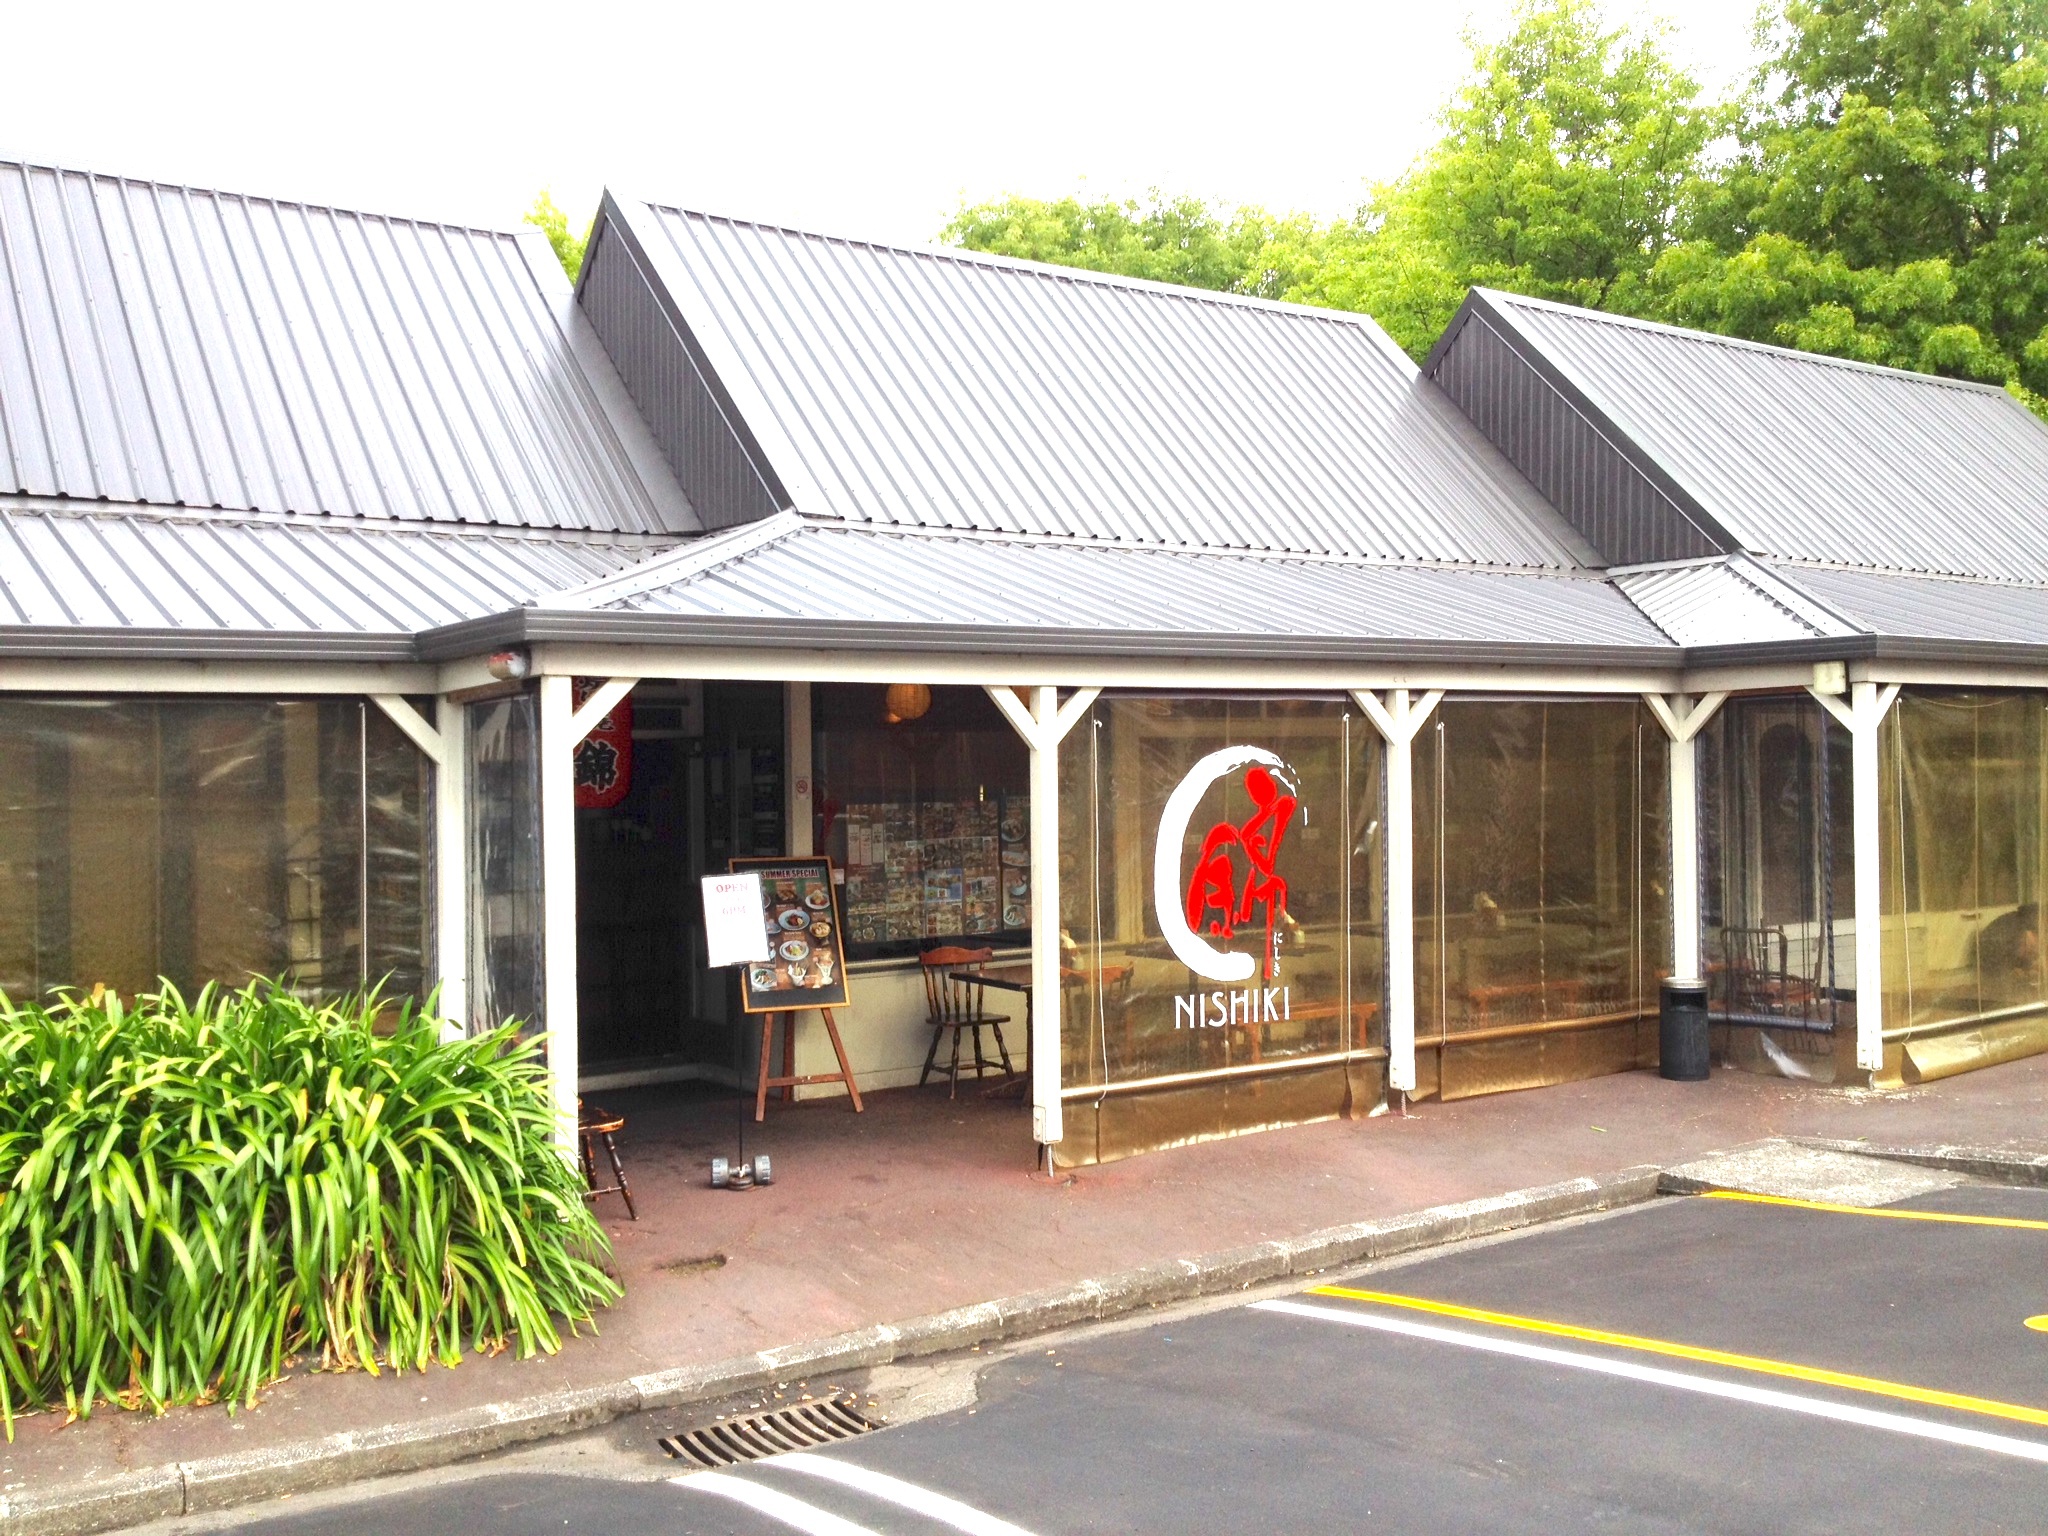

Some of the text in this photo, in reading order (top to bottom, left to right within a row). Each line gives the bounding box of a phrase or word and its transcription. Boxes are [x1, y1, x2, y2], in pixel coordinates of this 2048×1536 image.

[760, 867, 818, 880] SUMMER SPECIAL
[716, 883, 748, 893] OPEN
[1273, 931, 1284, 977] にしき
[1174, 986, 1290, 1030] NISHIKI
